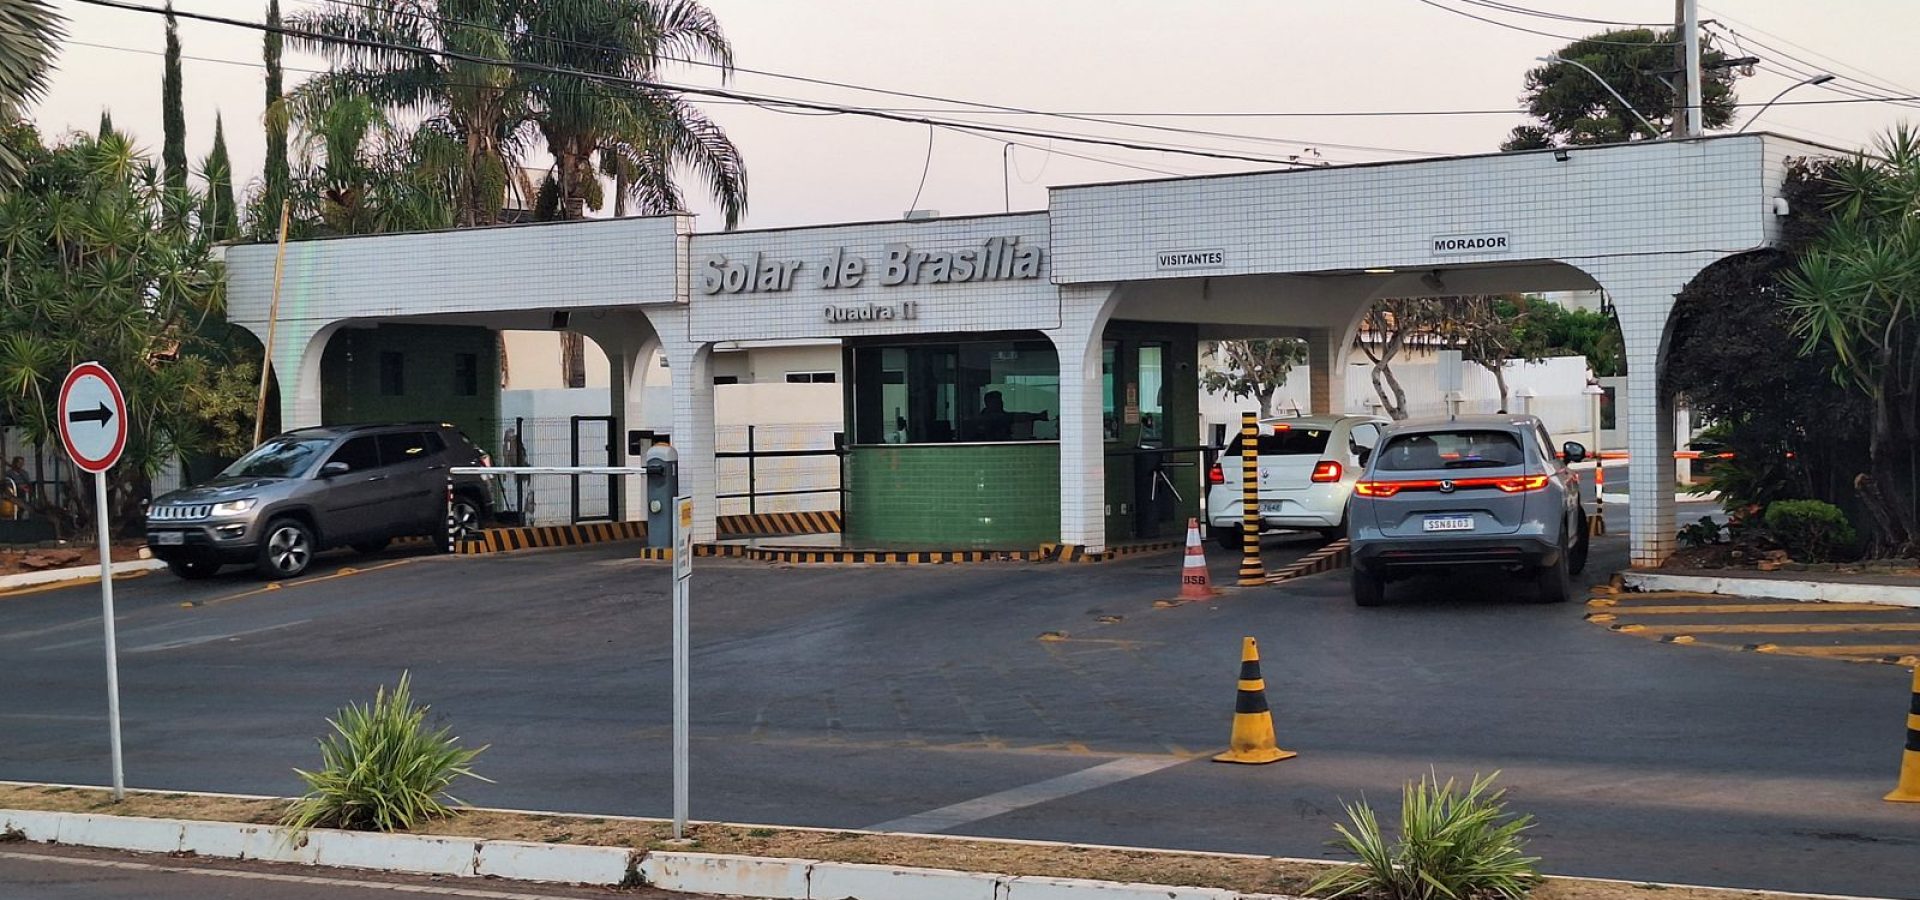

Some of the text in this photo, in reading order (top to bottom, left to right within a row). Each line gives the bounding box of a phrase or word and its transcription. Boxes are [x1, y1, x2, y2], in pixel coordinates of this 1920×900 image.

[1434, 237, 1507, 251] MORADOR
[701, 235, 1042, 295] Solar de Brasília
[1160, 252, 1222, 266] VISITANTES
[824, 303, 895, 324] Quadra
